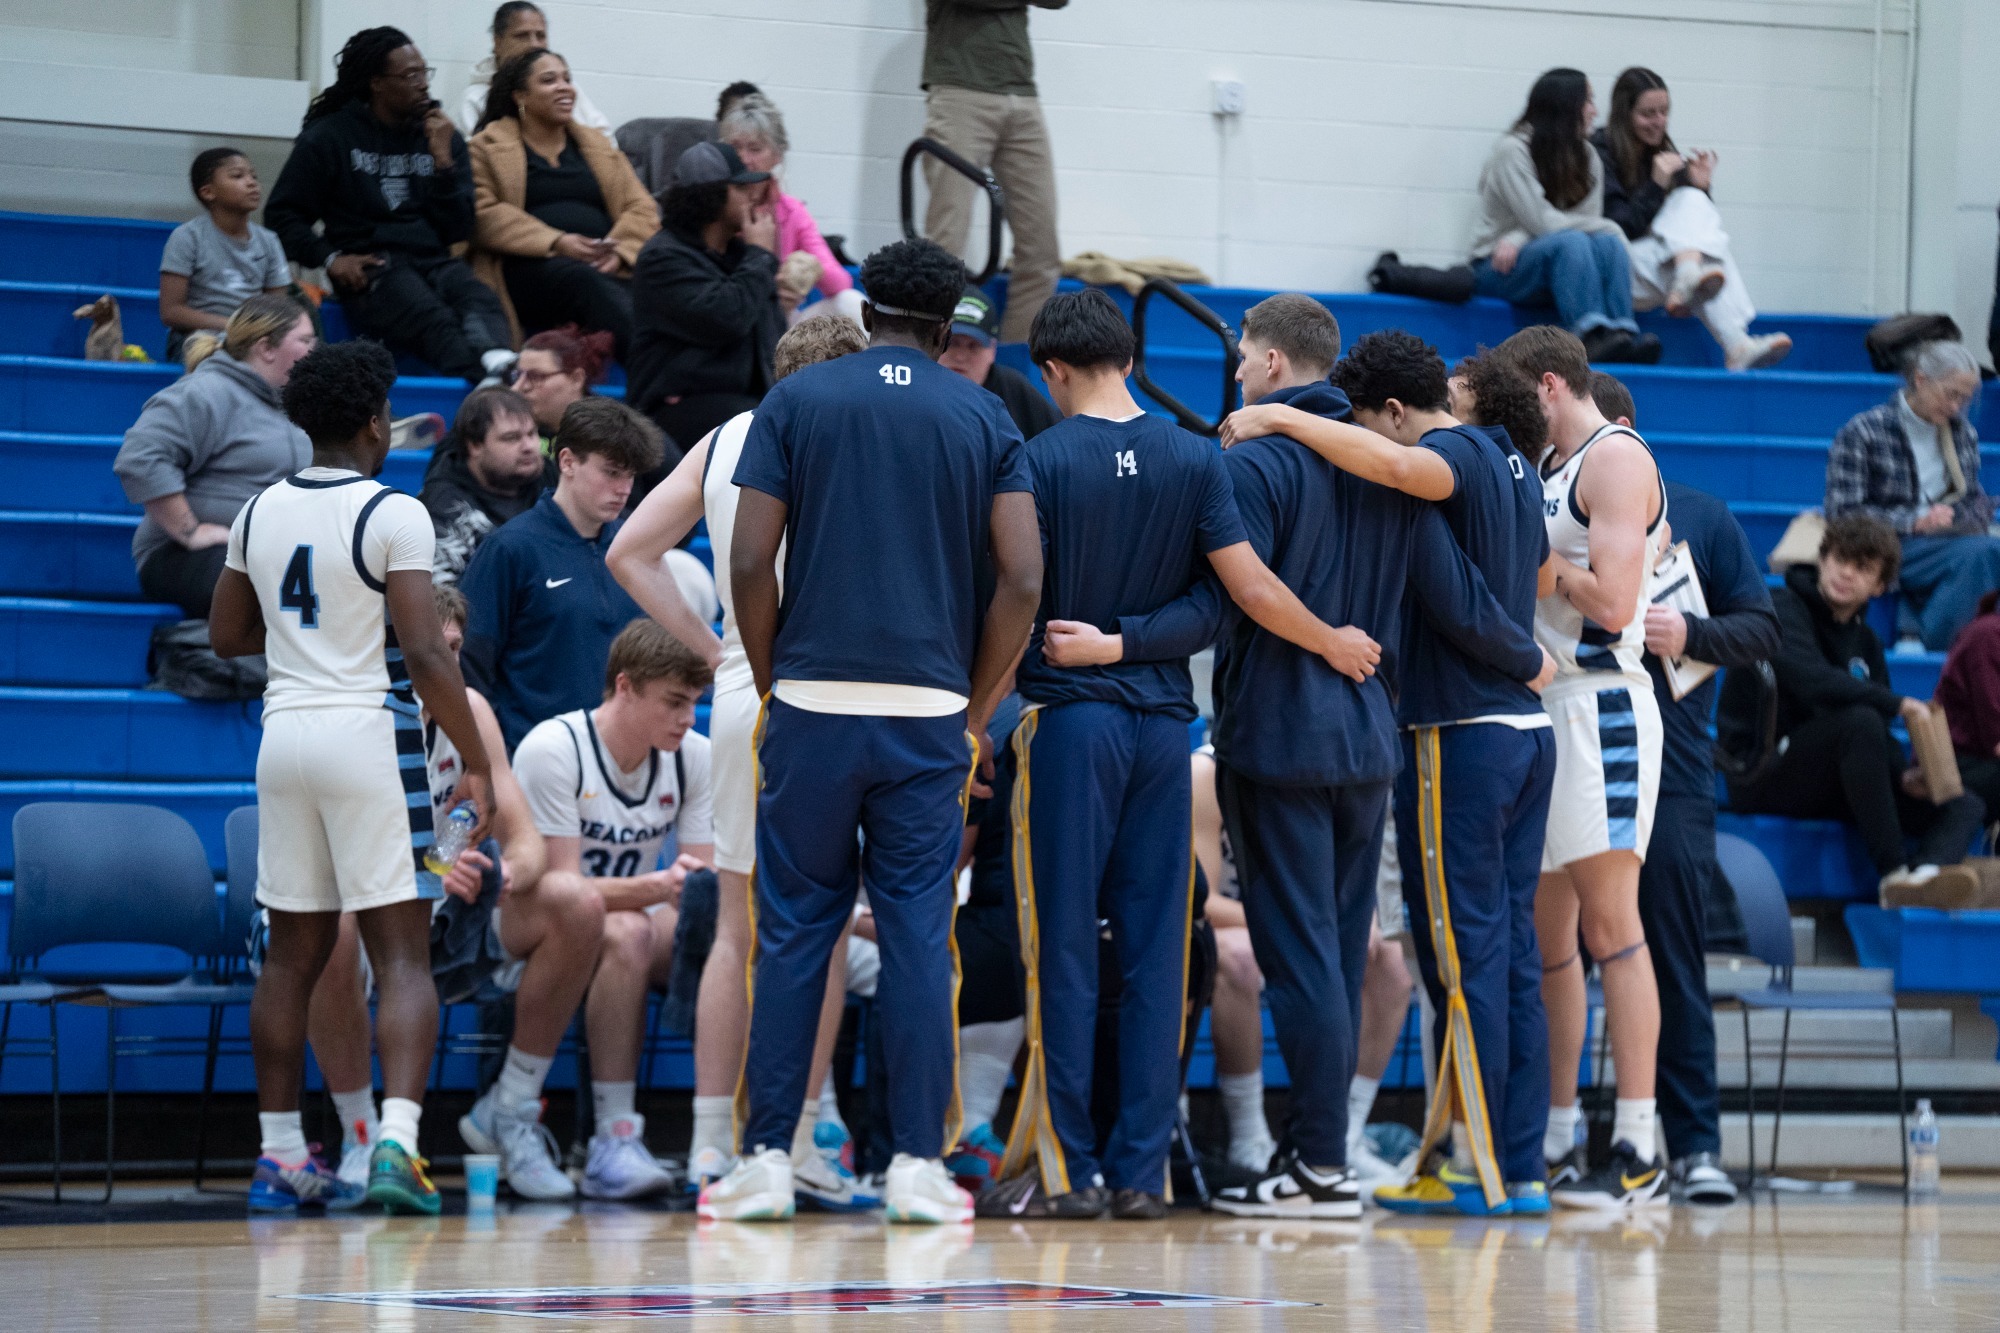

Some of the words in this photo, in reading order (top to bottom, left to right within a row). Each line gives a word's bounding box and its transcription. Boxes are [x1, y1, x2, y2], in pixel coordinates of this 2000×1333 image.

[879, 363, 911, 386] 40
[1115, 449, 1138, 477] 14
[279, 543, 320, 629] 4
[583, 848, 641, 878] 30
